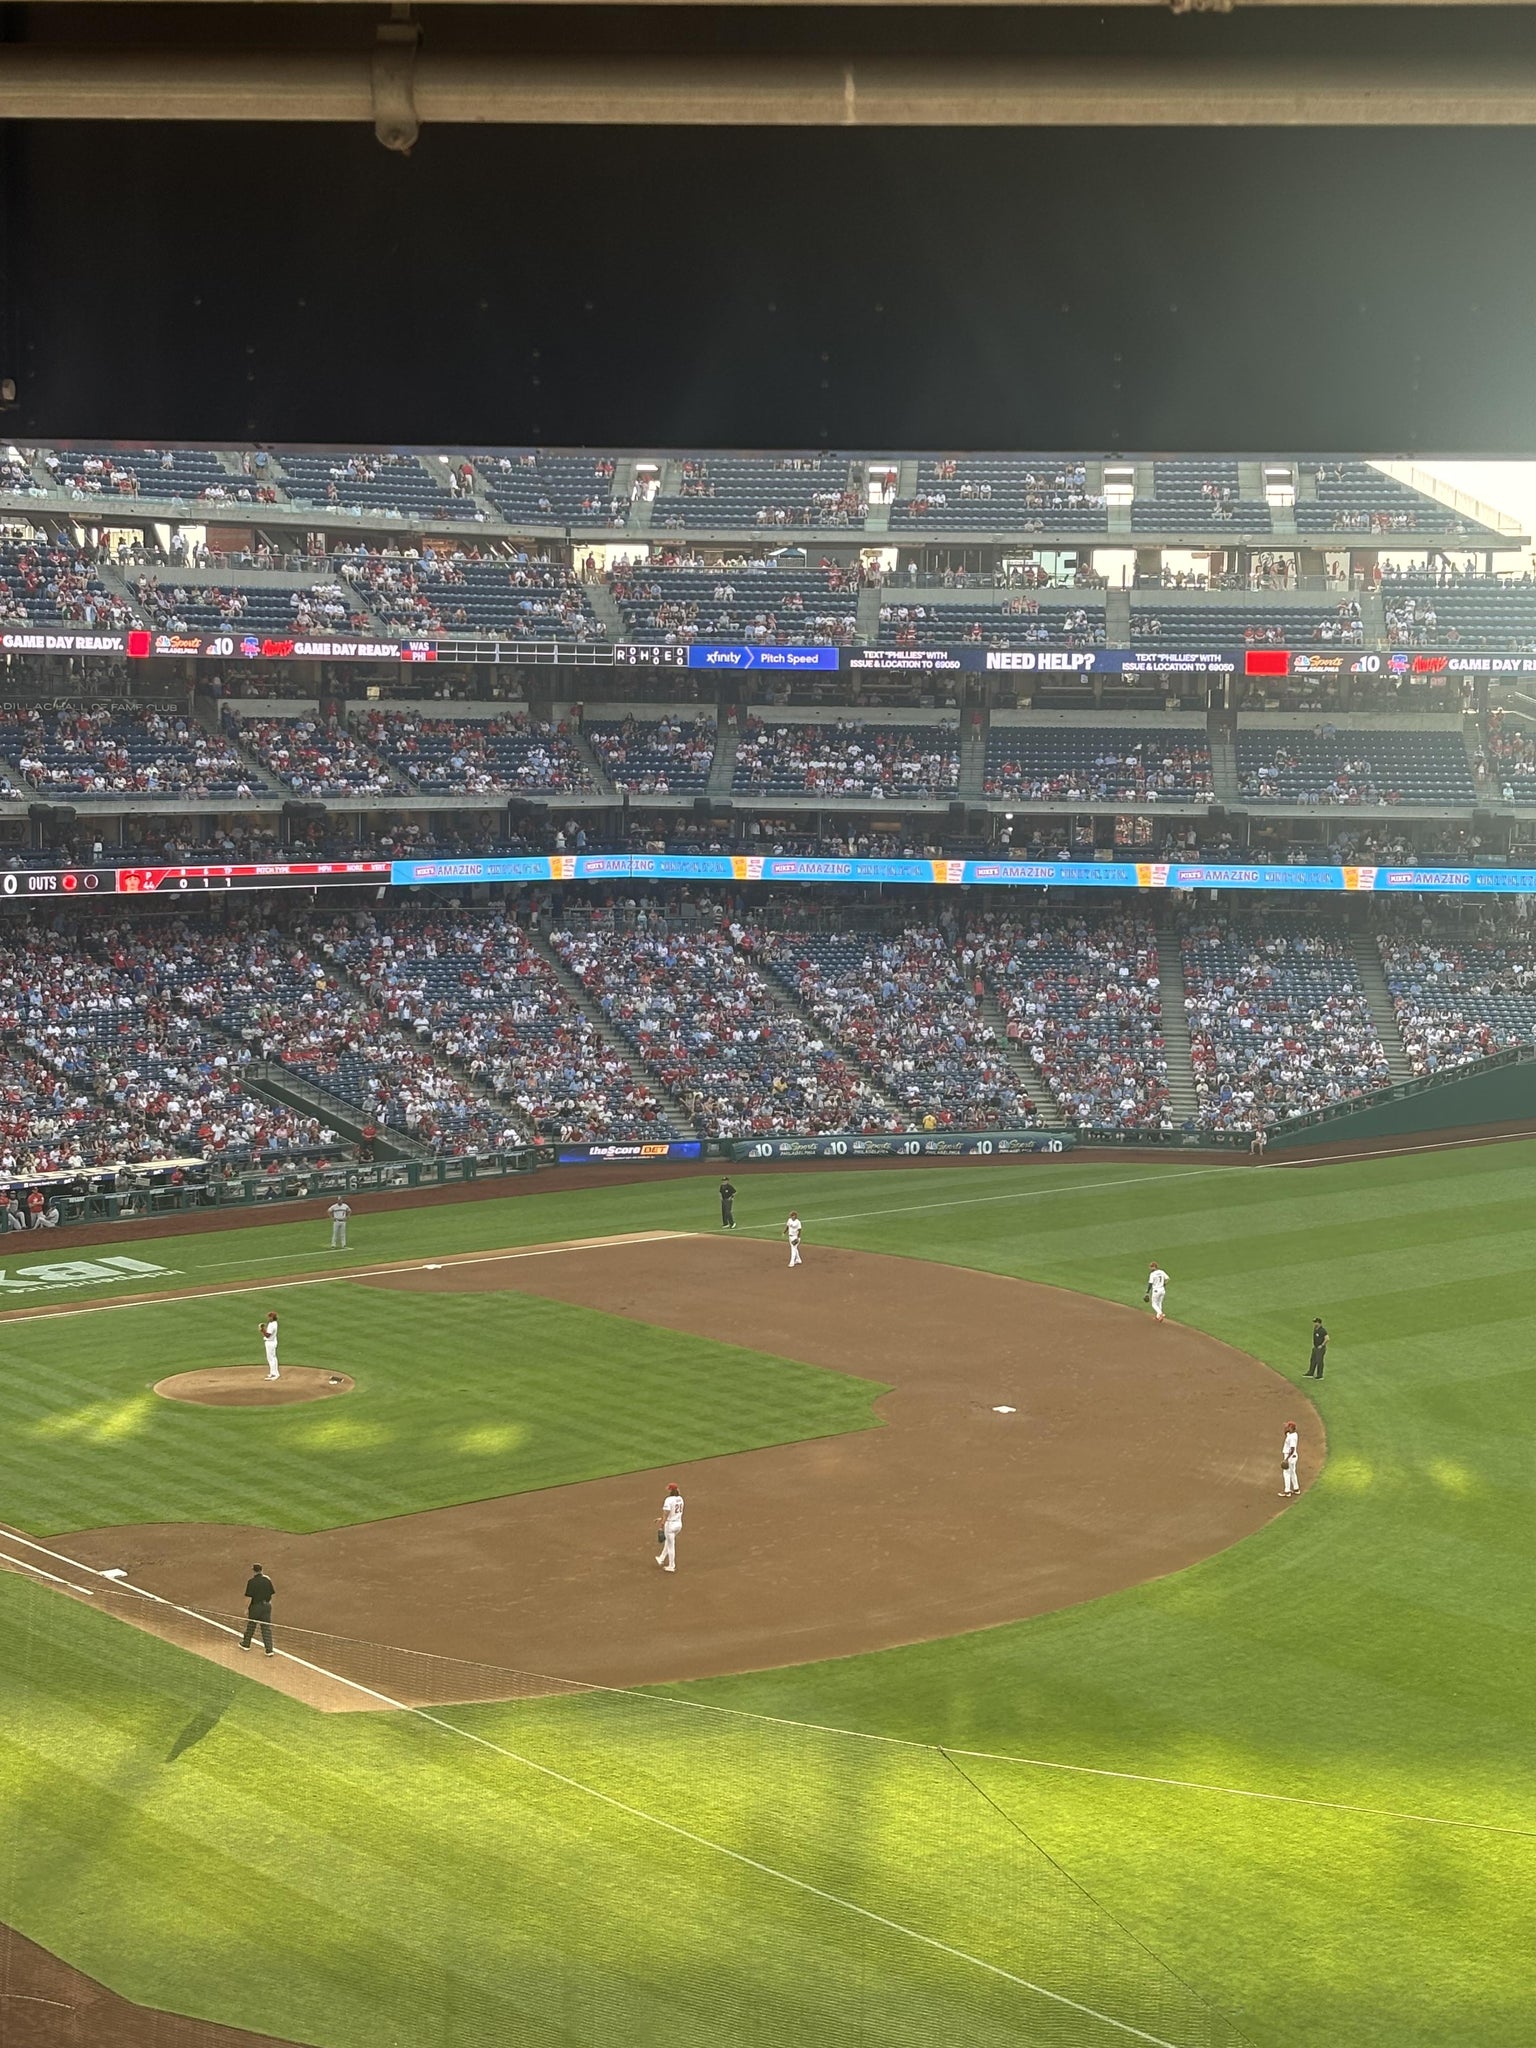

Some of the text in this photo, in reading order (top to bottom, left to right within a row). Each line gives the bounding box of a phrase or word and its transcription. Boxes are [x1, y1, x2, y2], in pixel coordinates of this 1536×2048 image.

[3, 635, 124, 650] GAME DAY READY.
[171, 636, 202, 648] Sports
[214, 638, 234, 655] 10
[409, 642, 430, 651] WAS
[294, 642, 331, 655] GAME
[332, 643, 357, 656] DAY
[358, 644, 400, 657] READY.
[617, 650, 625, 660] R
[629, 647, 637, 655] 0
[652, 647, 660, 655] 0
[676, 648, 684, 656] 0
[412, 652, 427, 661] PHI
[629, 656, 637, 664] 0
[640, 651, 649, 661] H
[652, 657, 660, 665] 0
[664, 651, 672, 661] E
[676, 657, 684, 665] 0
[706, 651, 741, 664] xfinity
[761, 651, 819, 665] Pitch Speed
[986, 652, 1096, 670] NEED HELP?
[1135, 653, 1157, 661] TEXT
[1199, 654, 1221, 662] WITH
[1309, 655, 1344, 666] Sports
[850, 660, 874, 668] ISSUE
[874, 660, 880, 668] &
[881, 660, 921, 669] LOCATION
[935, 661, 960, 669] 69050
[1122, 663, 1235, 672] ISSUE & LOCATION TO 69050
[1360, 655, 1380, 672] 10
[1449, 659, 1491, 670] GAME
[1492, 659, 1521, 670] DAY
[0, 702, 52, 711] DILLAC
[146, 703, 178, 712] CLUB
[437, 865, 482, 876] AMAZING
[606, 860, 655, 870] AMAZING
[799, 863, 851, 874] AMAZING
[145, 871, 152, 880] P
[1002, 867, 1054, 878] AMAZING
[1205, 870, 1259, 881] AMAZING
[4, 874, 57, 894] 0 OUTS
[180, 877, 231, 888] 0 1 1
[1416, 873, 1470, 884] AMAZING
[589, 1145, 668, 1156] theScore BET
[755, 1143, 772, 1157] 10
[830, 1141, 847, 1155] 10
[904, 1140, 920, 1155] 10
[977, 1140, 993, 1154] 10
[1048, 1140, 1063, 1153] 10
